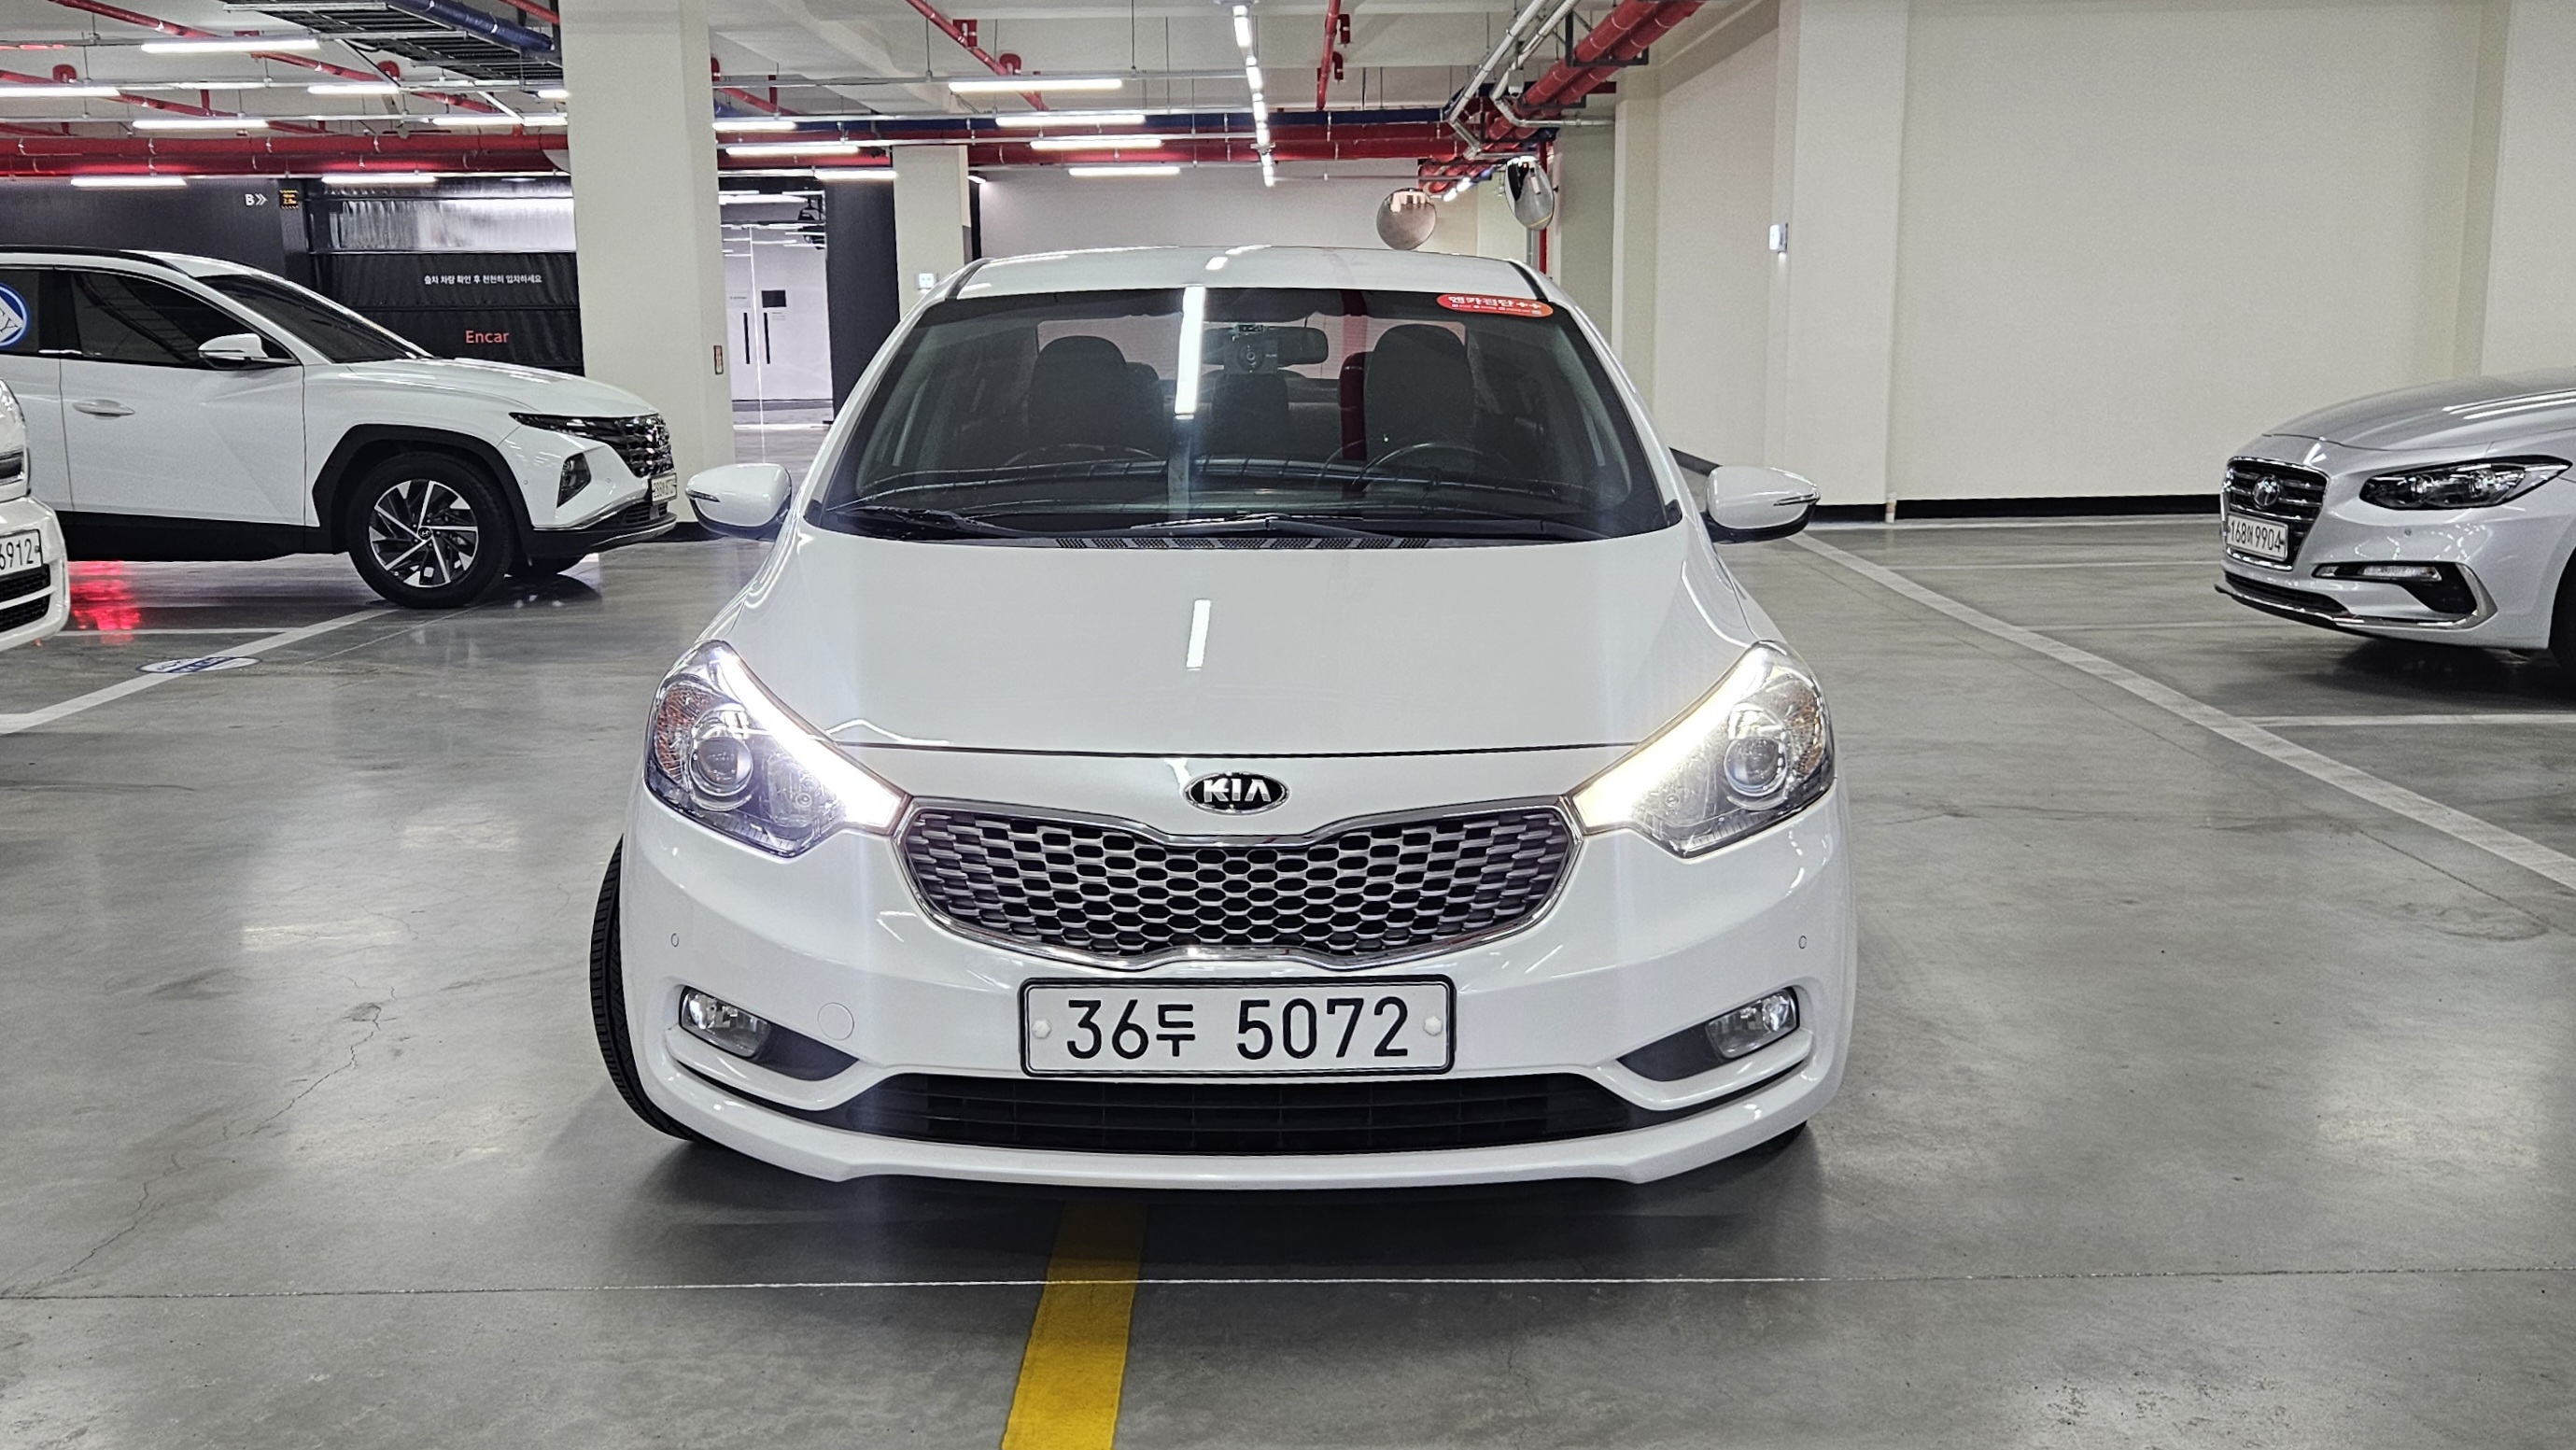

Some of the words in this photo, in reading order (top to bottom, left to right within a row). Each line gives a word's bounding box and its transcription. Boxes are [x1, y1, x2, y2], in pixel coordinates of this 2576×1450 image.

[245, 193, 255, 205] B
[440, 275, 456, 285] 차량
[457, 275, 472, 285] 확인
[472, 275, 481, 284] 후
[482, 275, 504, 284] 천천히
[505, 274, 542, 284] 입차하세요
[465, 330, 510, 344] Encar
[1204, 778, 1271, 803] KIA
[1066, 999, 1196, 1059] 36두
[1236, 996, 1408, 1060] 5072
